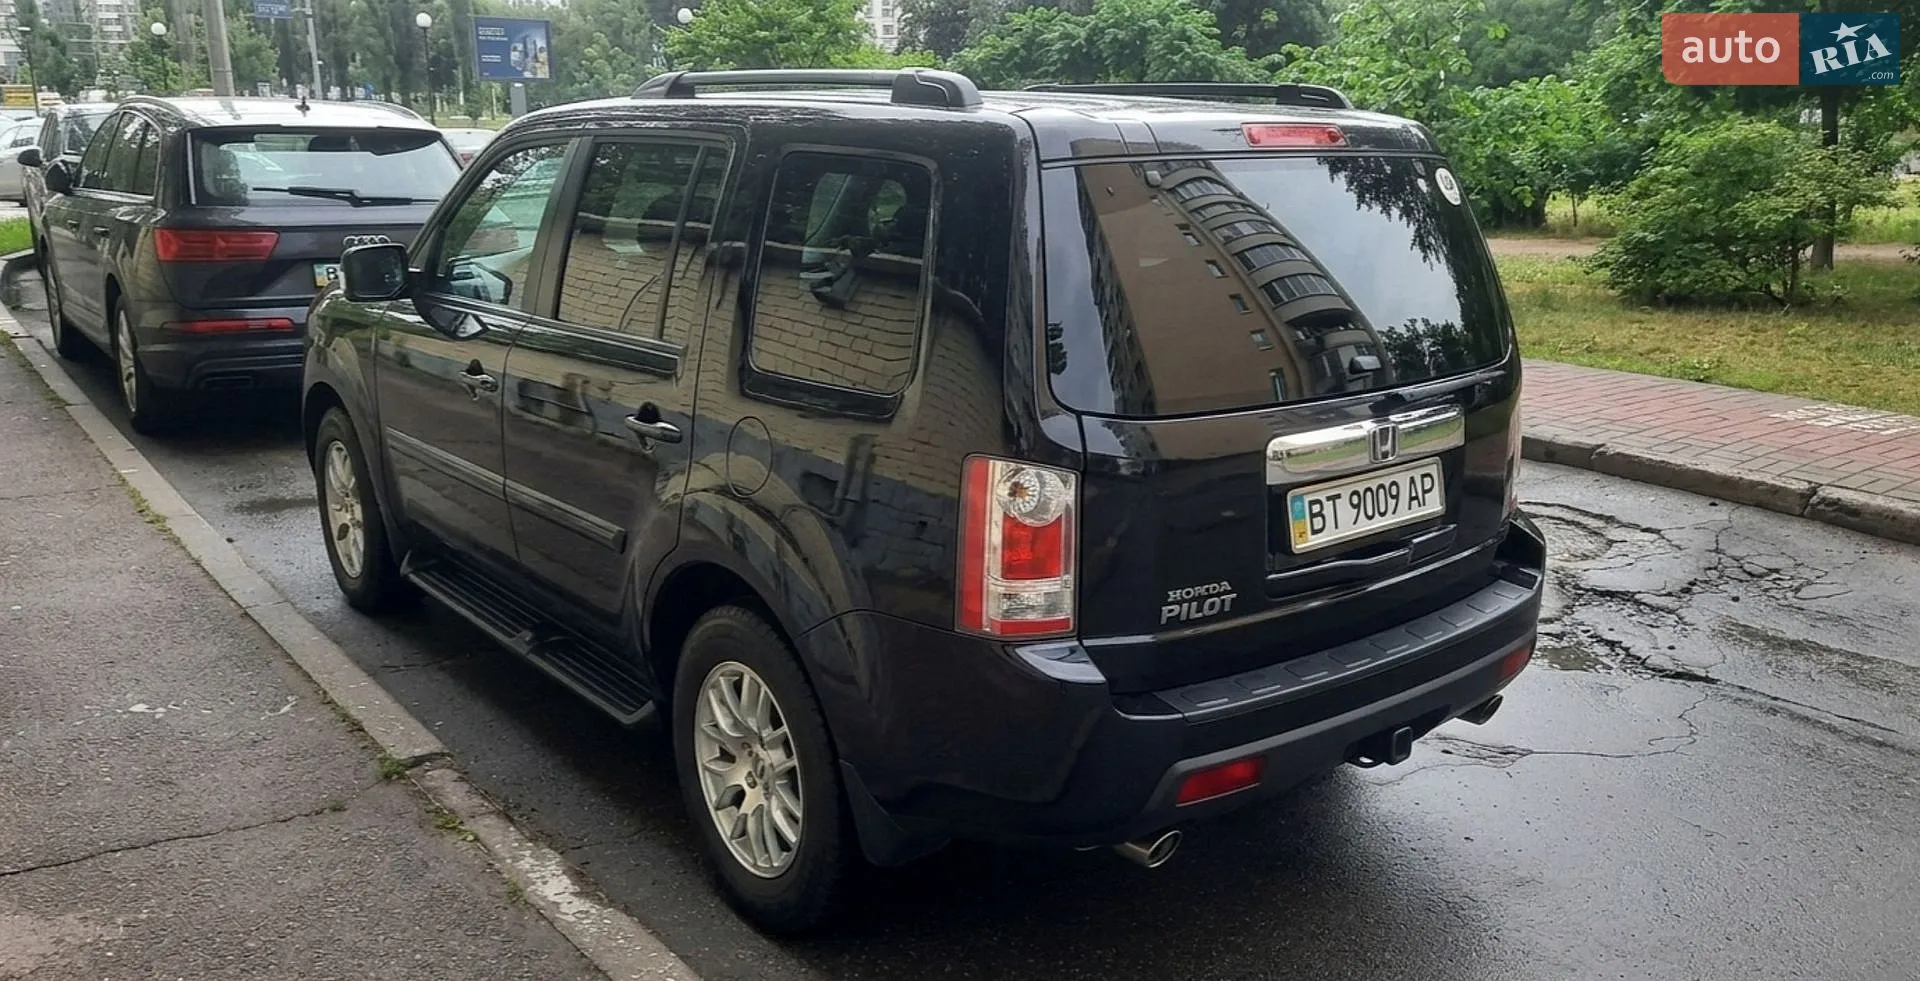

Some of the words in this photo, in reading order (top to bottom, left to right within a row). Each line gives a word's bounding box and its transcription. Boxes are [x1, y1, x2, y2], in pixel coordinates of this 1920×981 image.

[1308, 493, 1342, 535] BT
[1349, 480, 1401, 525] 9009
[1407, 472, 1435, 511] AP
[1168, 580, 1232, 602] HONDA
[1160, 593, 1237, 625] PILOT
